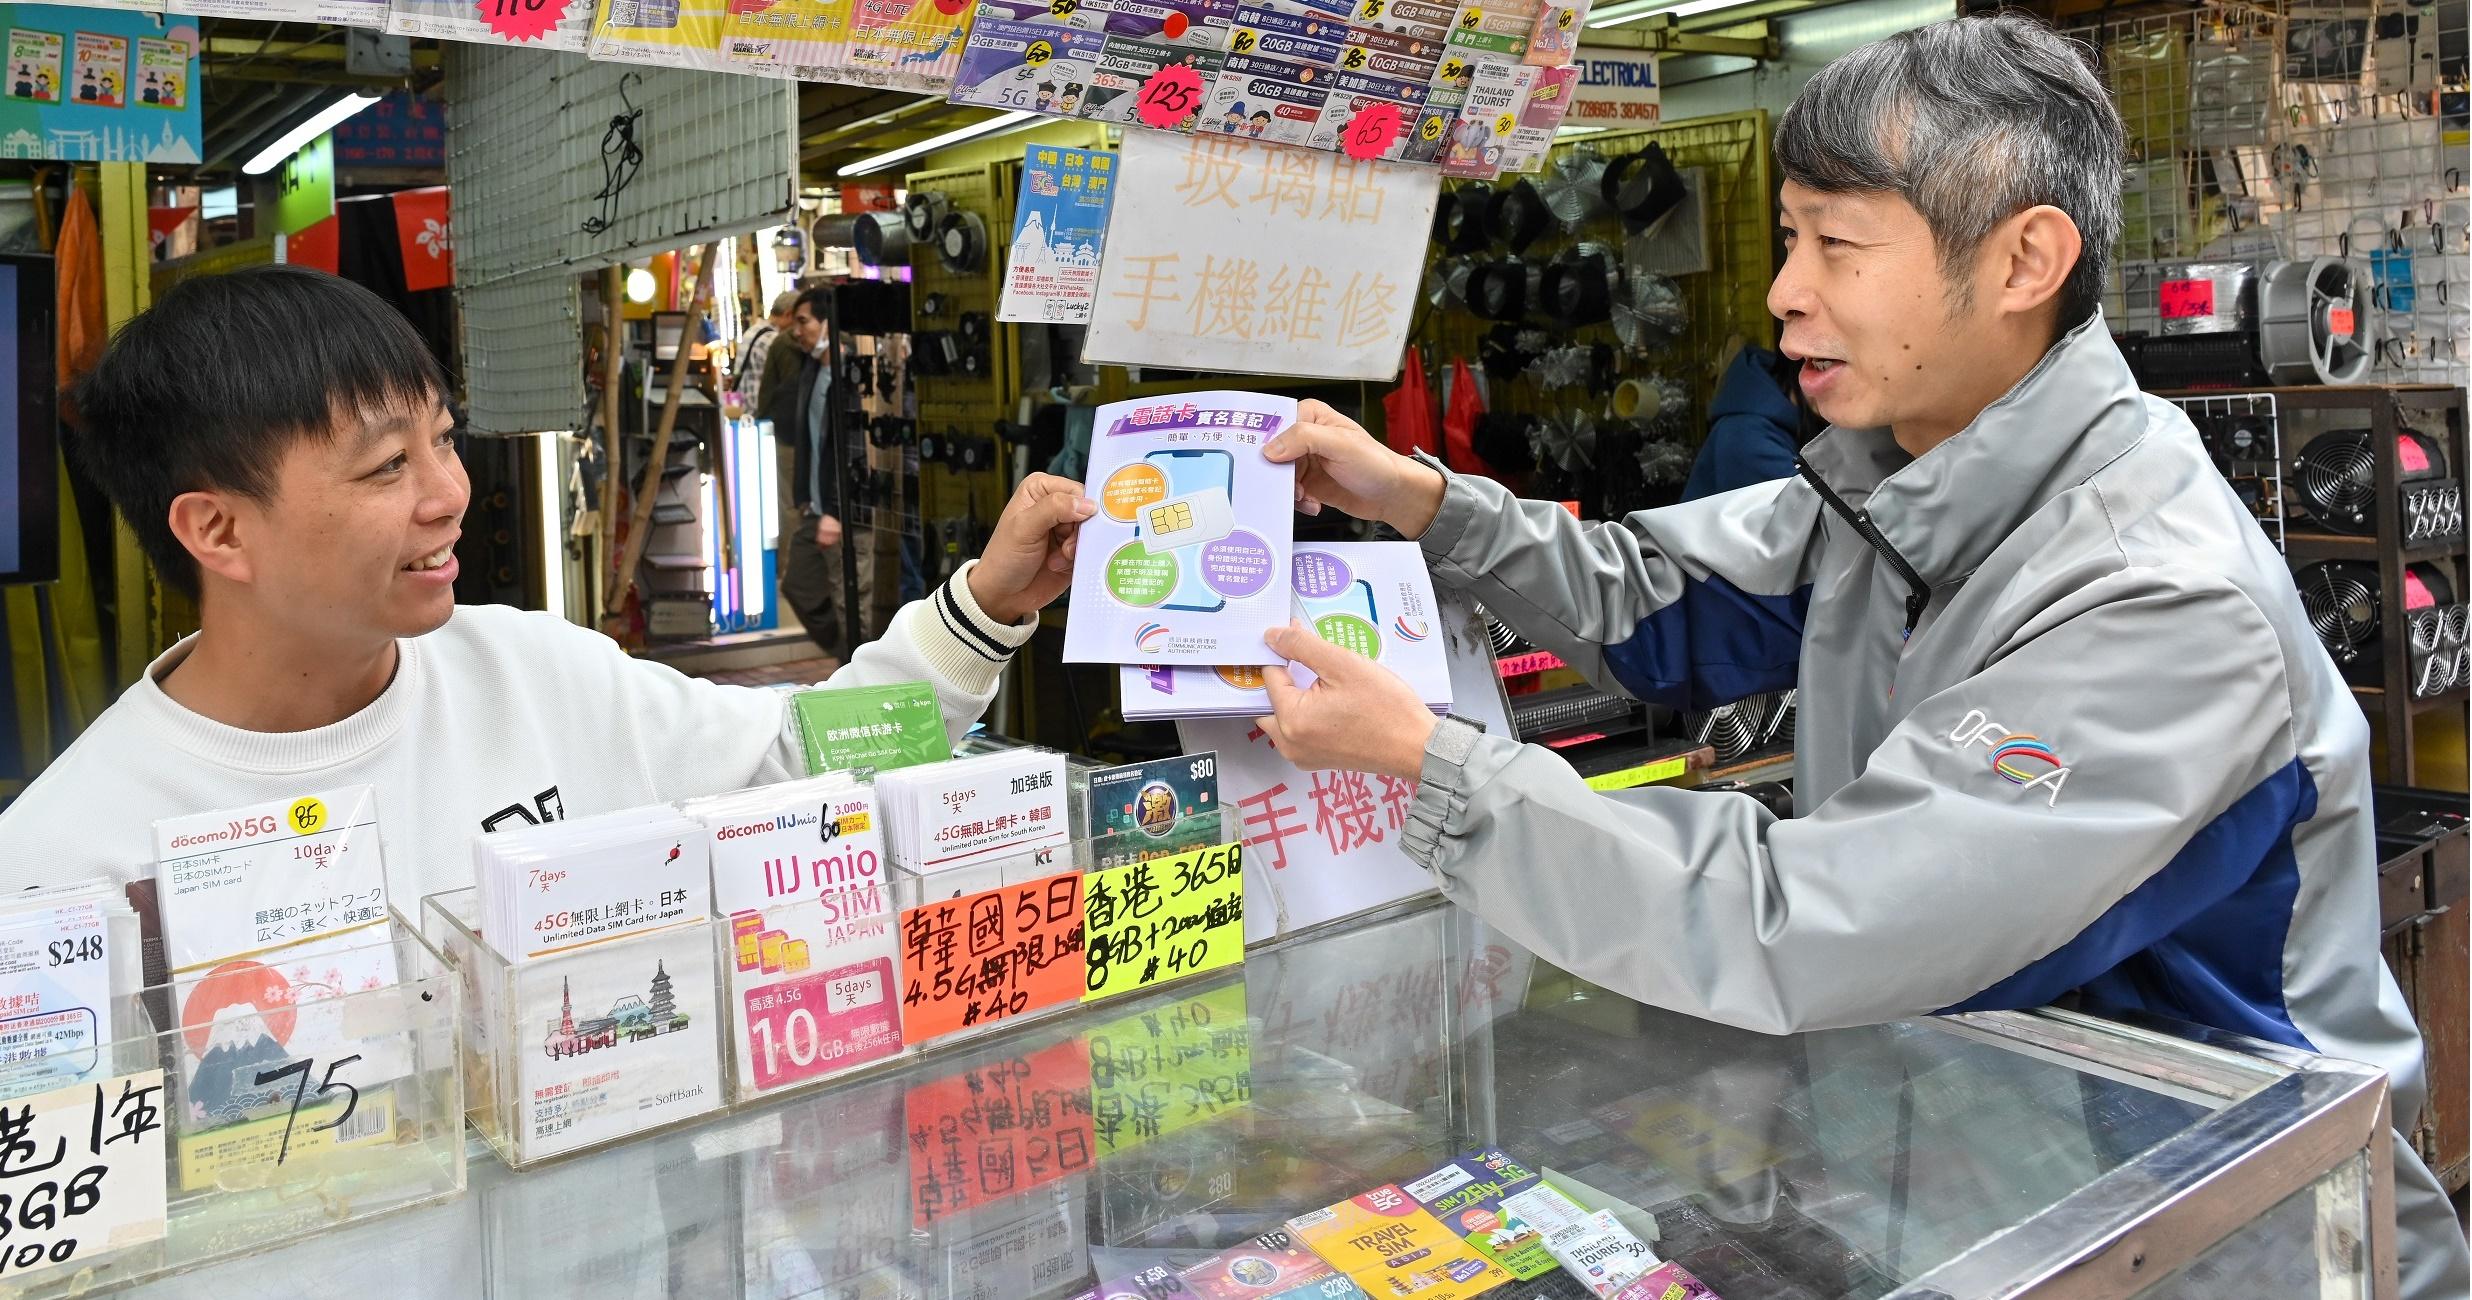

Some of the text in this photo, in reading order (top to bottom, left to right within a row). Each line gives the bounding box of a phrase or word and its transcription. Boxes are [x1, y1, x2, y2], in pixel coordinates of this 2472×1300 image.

[864, 1, 911, 16] 4G LTE
[1113, 1, 1142, 13] 60GB
[1395, 5, 1418, 18] 8GB
[738, 10, 841, 30] 日本無限上網卡
[1238, 10, 1261, 25] 南韓
[1558, 10, 1572, 28] 40
[855, 24, 960, 49] 日本無限上網卡
[1345, 31, 1367, 44] 亞洲
[1411, 26, 1424, 36] 60
[971, 34, 994, 47] 9GB
[1261, 37, 1293, 51] 20GB
[1534, 38, 1549, 48] No.1
[1100, 55, 1130, 69] 20GB
[1227, 57, 1249, 69] 南韓
[1369, 56, 1398, 71] 10GB
[1441, 63, 1461, 79] 30
[998, 88, 1029, 106] 5G
[1145, 81, 1199, 111] 125
[1250, 82, 1282, 97] 30GB
[1475, 85, 1514, 97] THAILAND
[1472, 95, 1512, 108] TOURIST
[1277, 106, 1291, 116] 40
[1356, 115, 1388, 146] 65
[1497, 117, 1511, 133] 30
[1038, 150, 1084, 168] 中國 日本
[1175, 135, 1391, 224] 玻璃貼
[1066, 301, 1089, 310] Lucky2
[1112, 252, 1399, 349] 手機維修
[1130, 403, 1264, 427] 電話卡 實名登記
[826, 722, 903, 741] 欧洲微信乐游卡
[831, 748, 850, 756] Europe
[1191, 758, 1214, 781] $80
[1011, 770, 1053, 795] 加強版
[943, 788, 976, 805] 5days
[295, 803, 318, 829] 85
[953, 803, 962, 814] 天
[171, 815, 277, 849] docomo 5G
[716, 821, 774, 841] docomo
[821, 803, 841, 843] 60
[942, 841, 972, 853] Unlimited
[1011, 828, 1027, 837] South
[1029, 825, 1046, 834] Korea
[172, 855, 221, 872] 日本SIM卡
[315, 857, 328, 870] 天
[763, 844, 877, 897] IIJ mio
[174, 876, 243, 895] Japan SIM card
[541, 883, 550, 893] 天
[1085, 864, 1162, 932] 香港
[1171, 844, 1242, 897] 365日
[255, 887, 381, 925] 最強のネットワーク
[820, 880, 881, 925] SIM
[257, 905, 384, 943] 広く、速く、快適に
[543, 907, 684, 943] Unlimited Data SIM Card for Japan
[903, 876, 1078, 971] 韓國 5日
[827, 923, 885, 944] JAPAN
[48, 934, 103, 968] $248
[836, 979, 872, 996] 5days
[750, 989, 802, 1011] 高速 4.5G
[846, 993, 857, 1006] 天
[55, 1029, 84, 1041] 42Mbps
[752, 1008, 844, 1075] 10 GB
[655, 1084, 704, 1106] SoftBank
[91, 1080, 162, 1156] 1年
[254, 1053, 362, 1167] 75
[535, 1118, 572, 1136] 高速上網
[1487, 1152, 1502, 1161] AIS
[1495, 1164, 1528, 1181] 5G
[1366, 1187, 1392, 1201] true
[1373, 1194, 1404, 1212] 5G
[1435, 1195, 1460, 1212] SIM
[1457, 1180, 1505, 1206] 2Fly
[1348, 1222, 1418, 1252] TRAVEL
[1376, 1237, 1416, 1258] SIM
[1570, 1234, 1617, 1259] THAILAND
[1578, 1241, 1626, 1268] TOURIST
[1625, 1242, 1646, 1258] 30
[1390, 1248, 1429, 1267] ASIA
[1454, 1268, 1471, 1283] No.1
[1488, 1267, 1504, 1279] 399
[1320, 1277, 1353, 1299] $238
